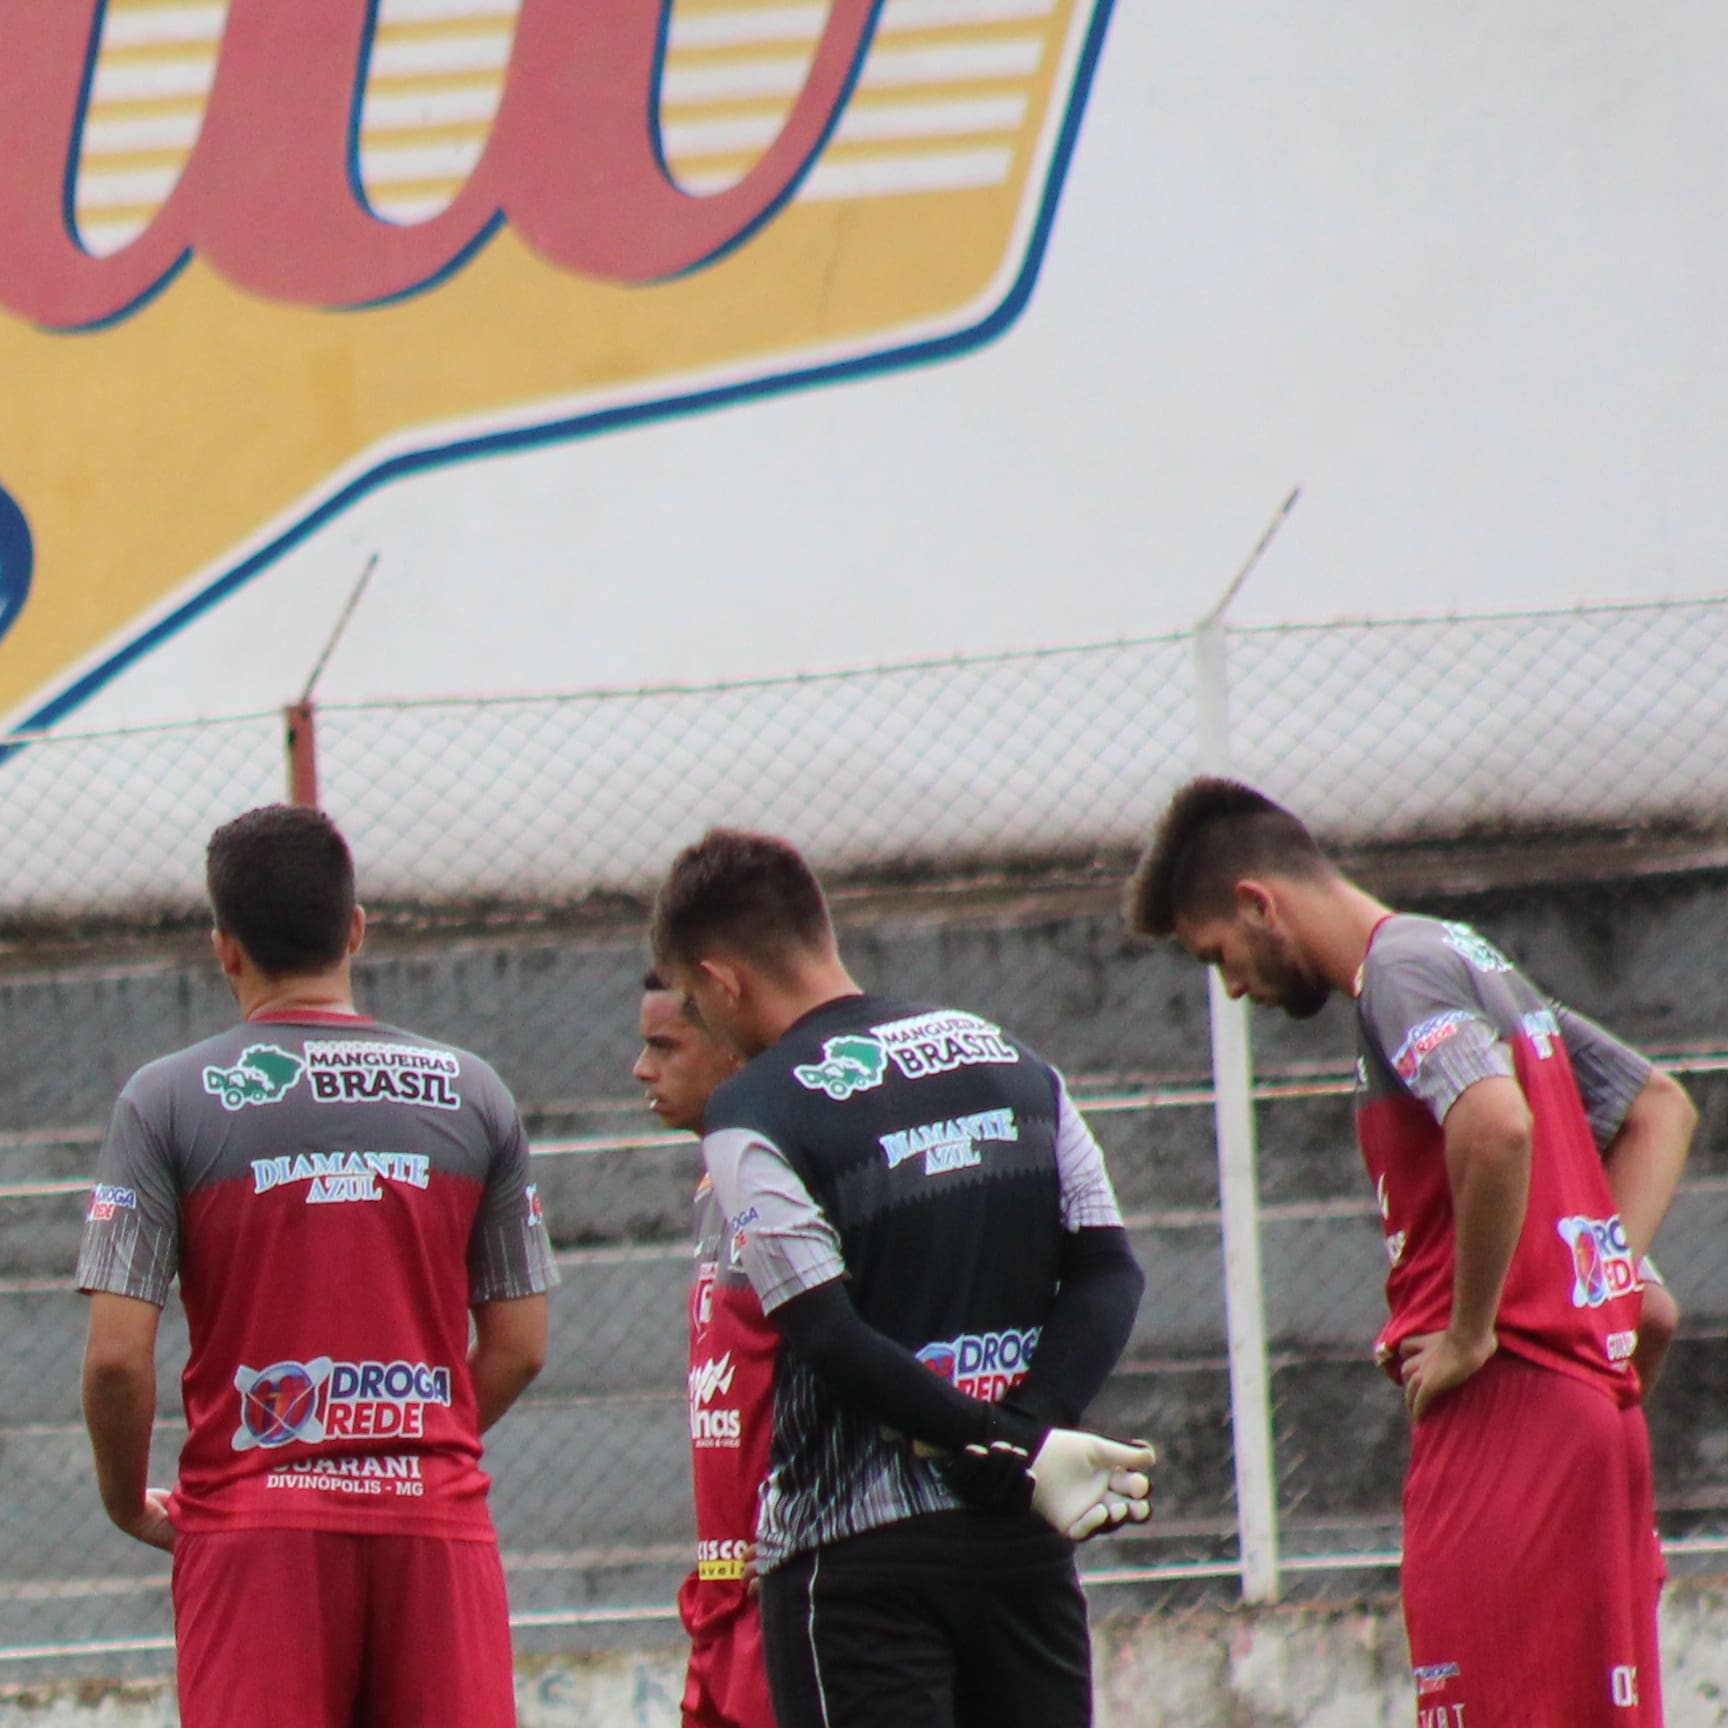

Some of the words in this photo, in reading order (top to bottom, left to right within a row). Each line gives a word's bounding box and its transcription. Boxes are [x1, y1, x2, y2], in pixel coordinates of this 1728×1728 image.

[309, 1051, 457, 1073] MANGUEIRAS
[895, 1033, 1014, 1075] BRASIL
[312, 1070, 456, 1106] BRASIL
[251, 1153, 430, 1193] DIAMANTE
[306, 1176, 382, 1203] AZUL
[329, 1364, 449, 1405] DROGA
[325, 1402, 422, 1436] REDE
[266, 1474, 381, 1493] DIVINÓPOLIS
[396, 1481, 424, 1496] MG
